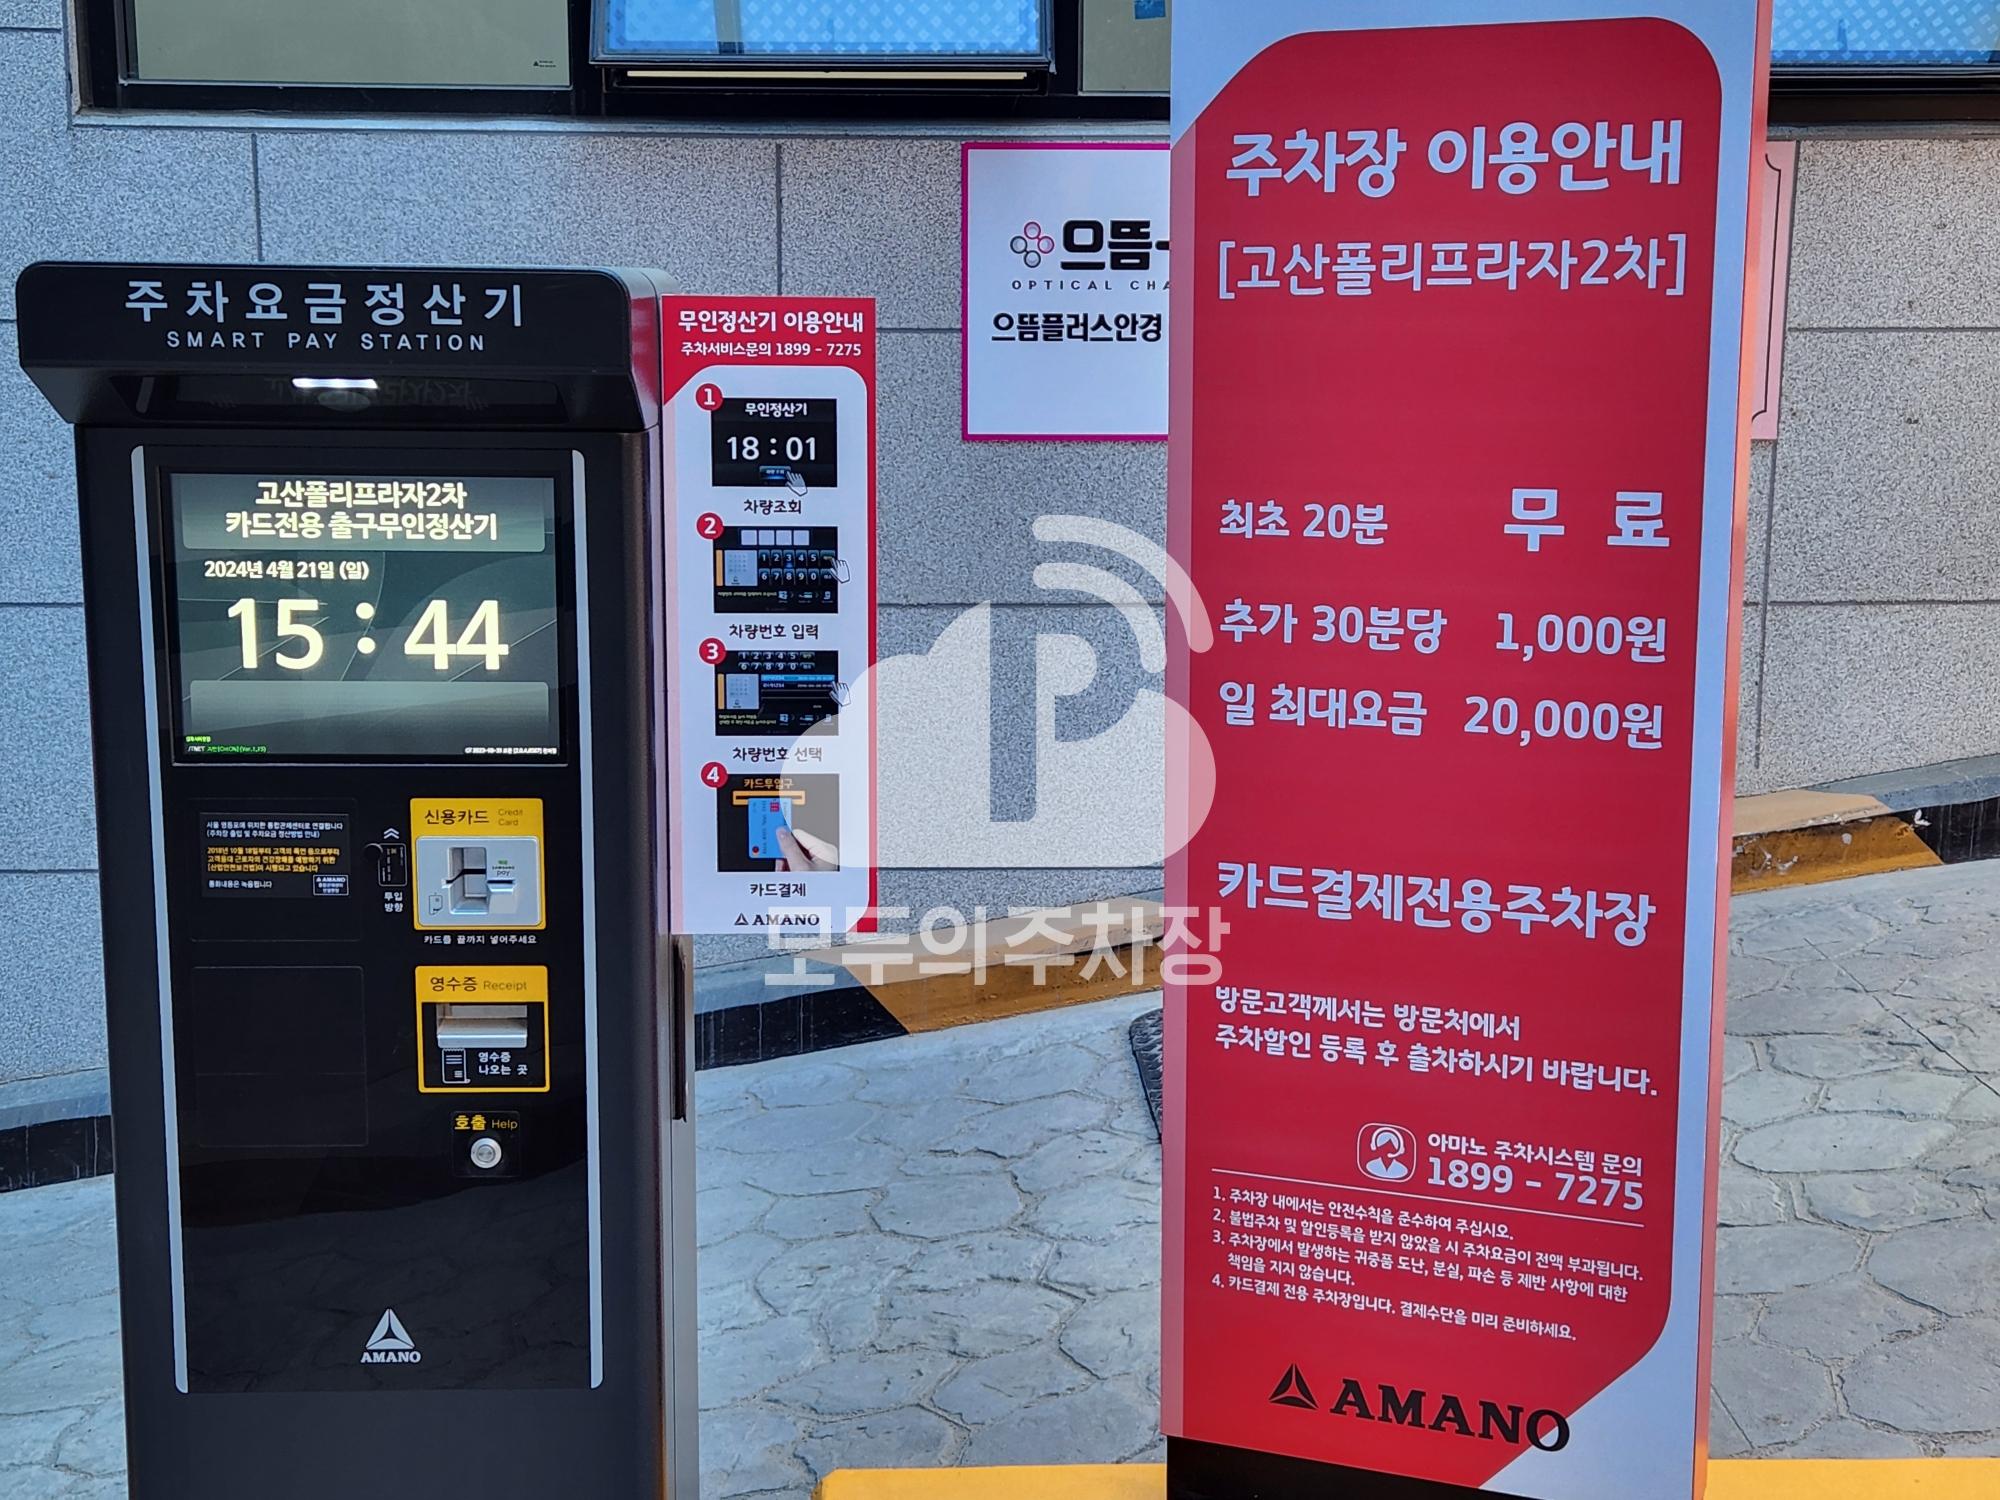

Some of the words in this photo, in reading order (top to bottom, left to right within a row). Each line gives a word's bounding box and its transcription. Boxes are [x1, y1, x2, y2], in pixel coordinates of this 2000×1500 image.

[1225, 127, 1407, 198] 주차장
[1427, 119, 1684, 195] 이용안내
[1219, 233, 1687, 300] [고산폴리프라자2차]
[1011, 280, 1113, 290] OPTICAL
[678, 310, 776, 333] 무인정산기
[783, 311, 864, 334] 이용안내
[991, 312, 1162, 342] 으뜸플러스안경
[167, 330, 265, 349] SMART
[288, 332, 337, 349] PAY
[361, 333, 484, 351] STATION
[681, 341, 772, 356] 주차서비스문의
[776, 342, 811, 356] 1899
[827, 343, 862, 356] 7275
[703, 388, 716, 406] 1
[745, 403, 807, 417] 무인정산기
[255, 481, 467, 509] 고산폴리프라자2차
[744, 499, 802, 515] 차량조회
[225, 511, 324, 539] 카드전용
[328, 511, 498, 540] 출구무인정산기
[704, 517, 717, 535] 2
[1219, 498, 1290, 539] 최초
[1302, 503, 1388, 546] 20분
[204, 560, 263, 579] 2024년
[266, 560, 294, 579] 4월
[296, 561, 334, 579] 21일
[339, 561, 369, 580] (일)
[729, 624, 786, 640] 차량번호
[791, 624, 819, 640] 입력
[1219, 597, 1298, 644] 추가
[1312, 605, 1448, 654] 30분당
[1495, 612, 1667, 664] 1,000원
[706, 642, 719, 660] 3
[1219, 681, 1255, 727] 일
[1268, 683, 1428, 737] 최대요금
[1463, 696, 1664, 750] 20,000원
[733, 747, 789, 762] 차량번호
[794, 747, 822, 762] 선택
[744, 778, 794, 790] 카드투입구
[424, 809, 490, 825] 신용카드
[498, 808, 523, 817] Credit
[750, 883, 807, 898] 카드결제
[1217, 861, 1657, 947] 카드결제전용주차장
[752, 913, 820, 926] AMANO
[424, 935, 451, 945] 카드를
[457, 935, 485, 944] 끝까지
[490, 935, 537, 945] 넣어주세요
[430, 976, 478, 992] 영수증
[483, 981, 528, 991] Receipt
[1215, 985, 1386, 1028] 방문고객께서는
[1393, 1003, 1521, 1041] 방문처에서
[478, 1052, 511, 1063] 영수증
[1215, 1024, 1312, 1059] 주차할인
[1318, 1036, 1367, 1066] 등록
[1375, 1040, 1399, 1067] 후
[1406, 1042, 1534, 1083] 출차하시기
[1543, 1058, 1658, 1097] 바랍니다.
[478, 1064, 512, 1075] 나오는
[517, 1064, 528, 1076] 곳
[454, 1114, 487, 1131] 호출
[491, 1119, 518, 1131] Help
[1427, 1132, 1488, 1156] 아마노
[1494, 1140, 1595, 1172] 주차시스템
[1601, 1153, 1642, 1177] 문의
[1427, 1156, 1514, 1194] 1899
[1555, 1172, 1643, 1211] 7275
[1229, 1188, 1268, 1207] 주차장
[1272, 1194, 1325, 1215] 내에서는
[1328, 1201, 1395, 1225] 안전수칙을
[1398, 1210, 1451, 1232] 준수하여
[1456, 1218, 1514, 1240] 주십시오.
[1229, 1210, 1281, 1231] 불법주차
[1284, 1217, 1297, 1234] 및
[1300, 1219, 1365, 1243] 할인등록을
[1369, 1229, 1396, 1247] 받지
[1400, 1233, 1441, 1254] 않았을
[1445, 1240, 1459, 1255] 시
[1462, 1242, 1531, 1266] 주차요금이
[1535, 1251, 1563, 1271] 전액
[1567, 1256, 1644, 1281] 부과됩니다.
[1227, 1252, 1266, 1274] 책임을
[1269, 1260, 1295, 1277] 지지
[1298, 1263, 1356, 1286] 않습니다.
[1228, 1231, 1293, 1255] 주차장에서
[1297, 1241, 1351, 1264] 발생하는
[1354, 1249, 1394, 1271] 귀중품
[1397, 1256, 1429, 1276] 도난,
[1432, 1260, 1464, 1281] 분실,
[1467, 1265, 1496, 1284] 파손
[1499, 1269, 1514, 1287] 등
[1517, 1272, 1547, 1292] 제반
[1550, 1278, 1594, 1297] 사항에
[1598, 1284, 1629, 1303] 대한
[1228, 1275, 1280, 1297] 카드결제
[1283, 1283, 1309, 1302] 전용
[1312, 1288, 1396, 1314] 주차장입니다.
[1399, 1300, 1468, 1326] 결제수단을
[1471, 1311, 1499, 1329] 미리
[1502, 1316, 1577, 1341] 준비하세요.
[360, 1350, 422, 1363] AMANO
[1329, 1377, 1570, 1452] AMANO
